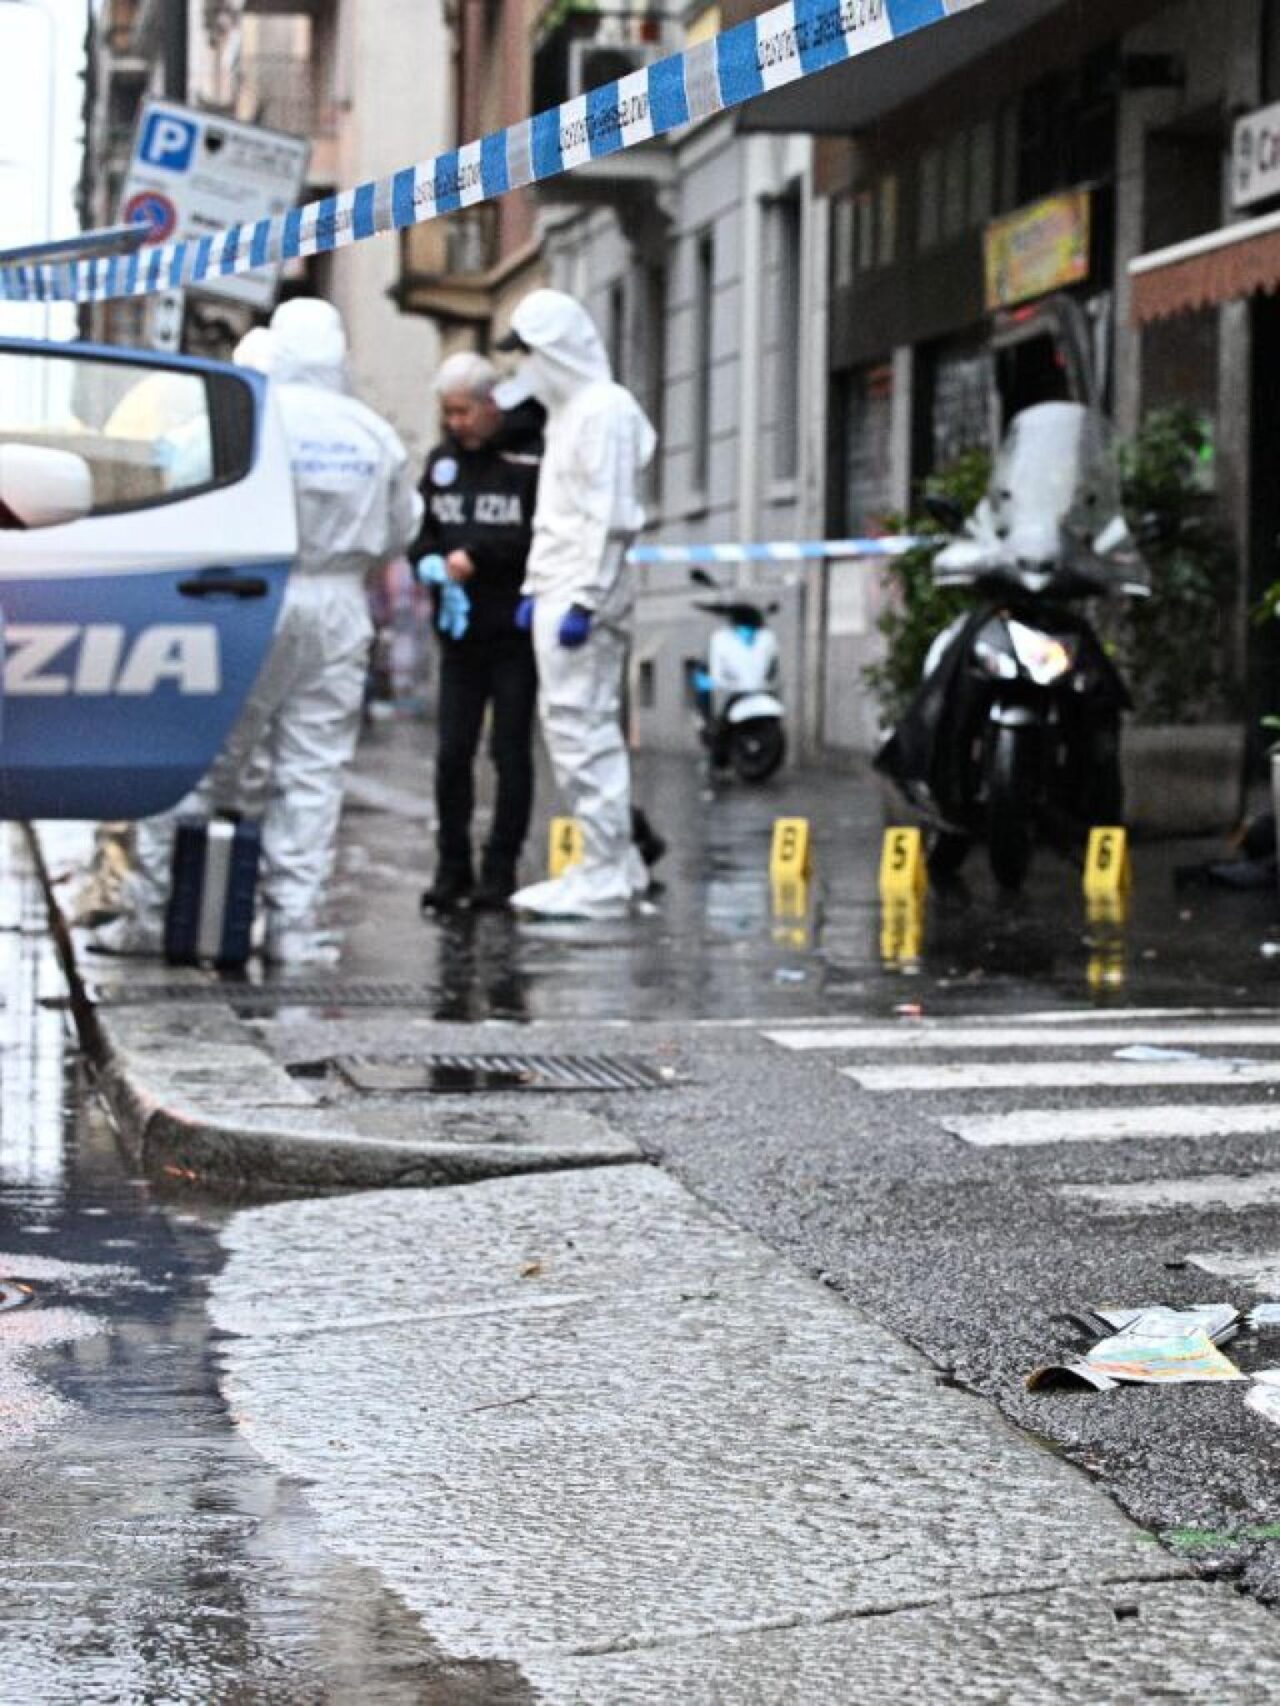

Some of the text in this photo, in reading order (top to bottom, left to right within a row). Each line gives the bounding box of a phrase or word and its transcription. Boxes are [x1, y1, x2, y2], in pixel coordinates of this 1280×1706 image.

[148, 119, 189, 162] P
[2, 621, 222, 698] ZIA
[891, 831, 910, 873] 5
[1096, 831, 1115, 873] 6
